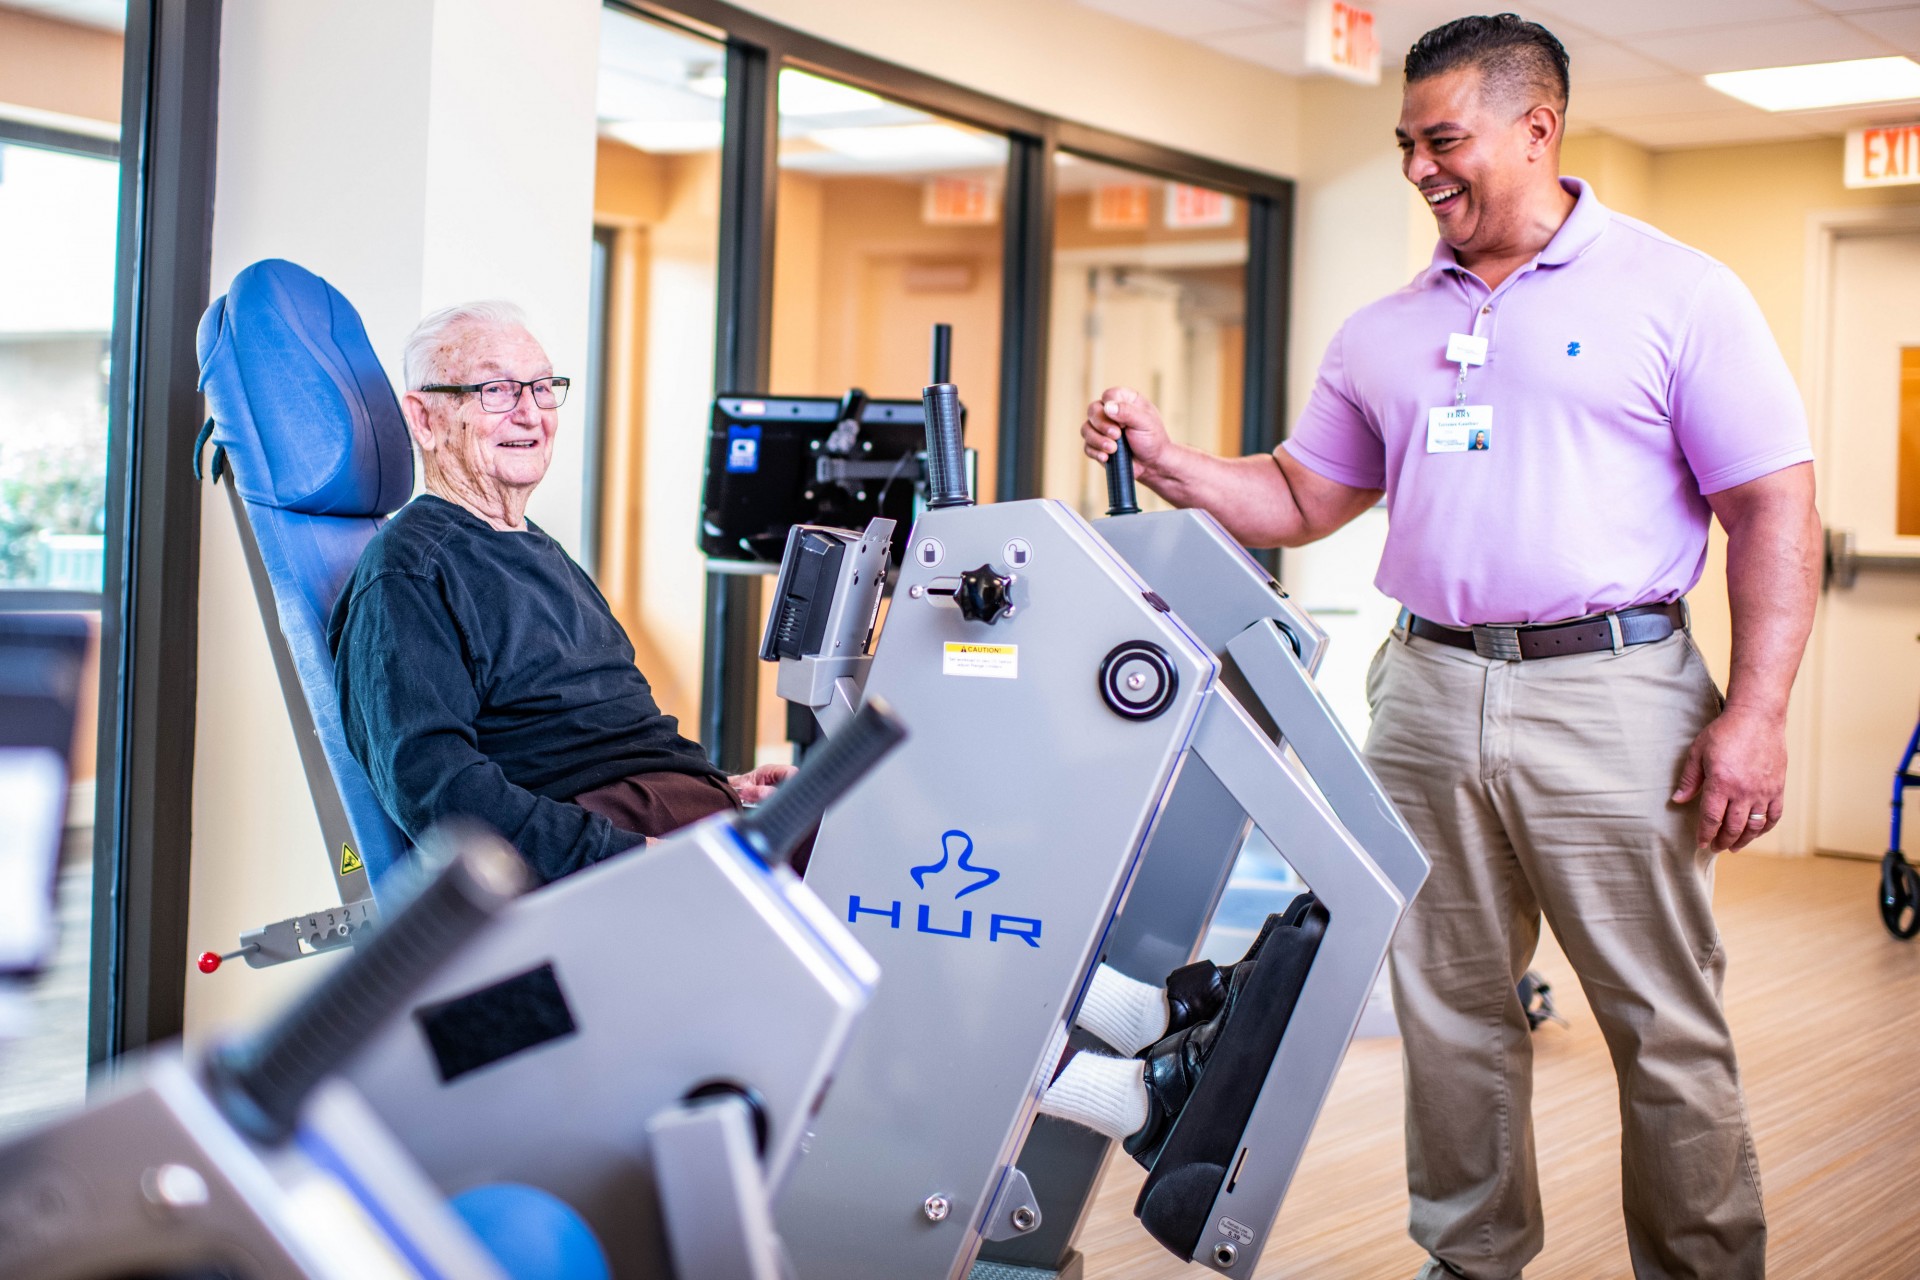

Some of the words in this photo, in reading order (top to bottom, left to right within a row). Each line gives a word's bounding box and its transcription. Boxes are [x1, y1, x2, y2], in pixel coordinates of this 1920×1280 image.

[309, 918, 318, 930] 4
[327, 914, 335, 926] 3
[344, 909, 352, 922] 2
[362, 905, 367, 917] 1
[848, 895, 1042, 948] HUR
